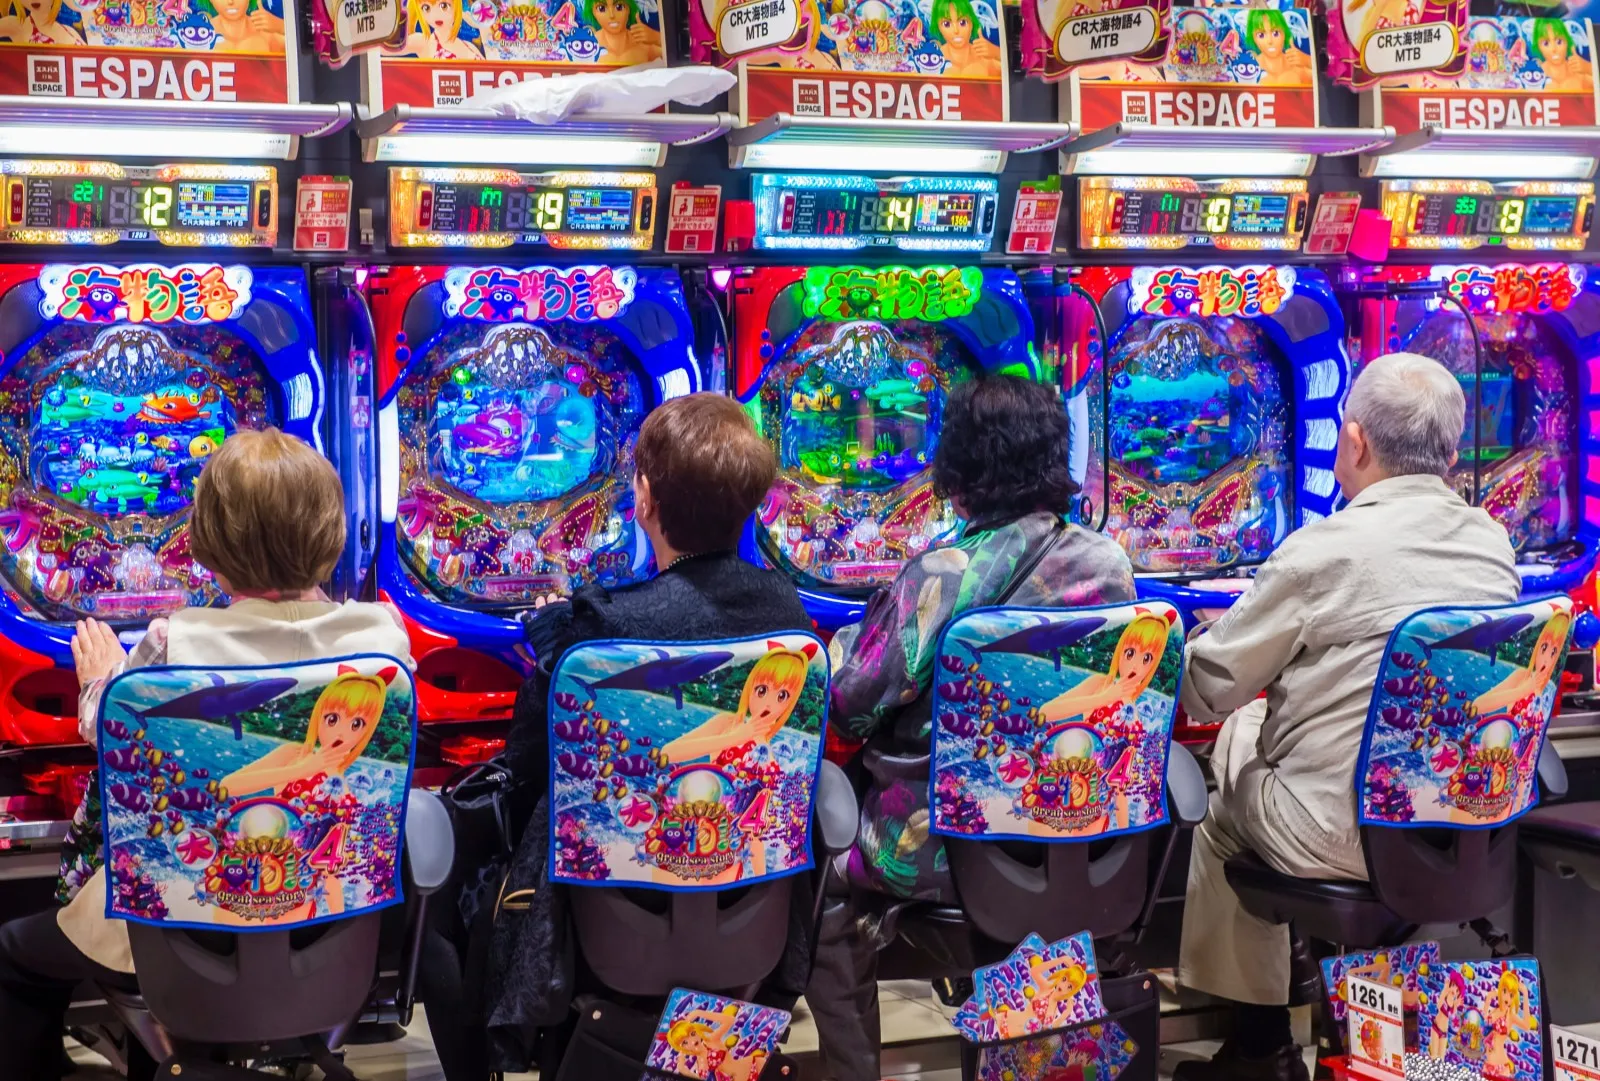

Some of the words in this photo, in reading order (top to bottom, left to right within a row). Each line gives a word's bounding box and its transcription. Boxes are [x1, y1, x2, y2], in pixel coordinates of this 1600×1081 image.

[357, 16, 376, 34] MTB
[551, 2, 578, 36] 4
[730, 5, 786, 28] CR大海物語4
[1072, 13, 1142, 37] CR大海物語4
[745, 22, 769, 41] MTB
[901, 17, 926, 50] 4
[1090, 33, 1119, 51] MTB
[1377, 29, 1441, 49] CR大海物語4
[1395, 47, 1421, 63] MTB
[32, 83, 63, 93] ESPACE
[72, 56, 237, 102] ESPACE
[797, 105, 821, 113] ESPACE
[829, 81, 962, 121] ESPACE
[1155, 92, 1275, 128] ESPACE
[1450, 98, 1561, 130] ESPACE
[73, 184, 103, 202] 221
[144, 187, 173, 226] 12
[536, 193, 564, 230] 19
[887, 197, 913, 232] 14
[951, 215, 968, 226] 1360
[1206, 198, 1231, 233] 10
[1107, 746, 1135, 790] 4
[739, 789, 773, 835] 4
[1032, 805, 1061, 818] great
[1082, 804, 1103, 817] story
[308, 824, 347, 875] 4
[656, 852, 687, 865] great
[689, 857, 708, 865] sea
[710, 851, 736, 865] story
[217, 889, 249, 904] great
[252, 894, 273, 903] sea
[276, 888, 309, 903] story
[1351, 982, 1385, 1010] 1261
[1557, 1036, 1598, 1068] 1271
